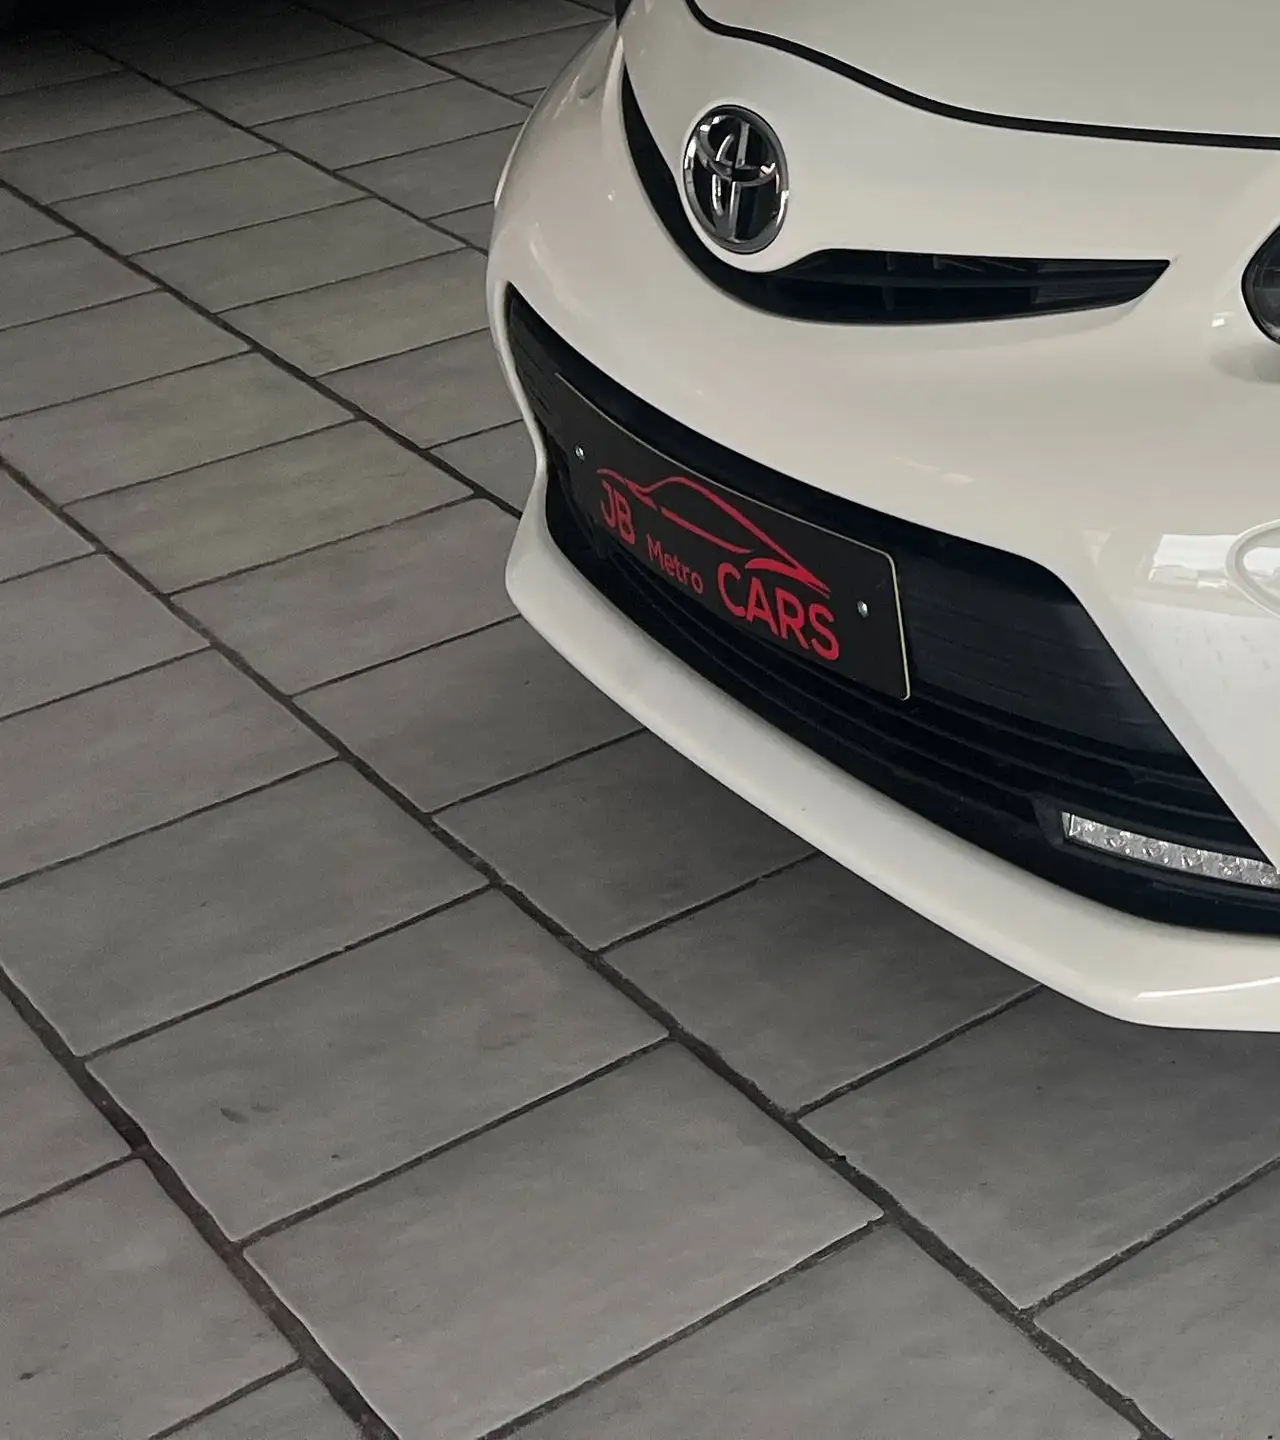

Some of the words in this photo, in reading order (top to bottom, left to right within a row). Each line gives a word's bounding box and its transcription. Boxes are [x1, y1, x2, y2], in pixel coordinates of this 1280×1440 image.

[601, 479, 635, 544] JB
[646, 533, 703, 594] Metro
[717, 562, 839, 660] CARS
